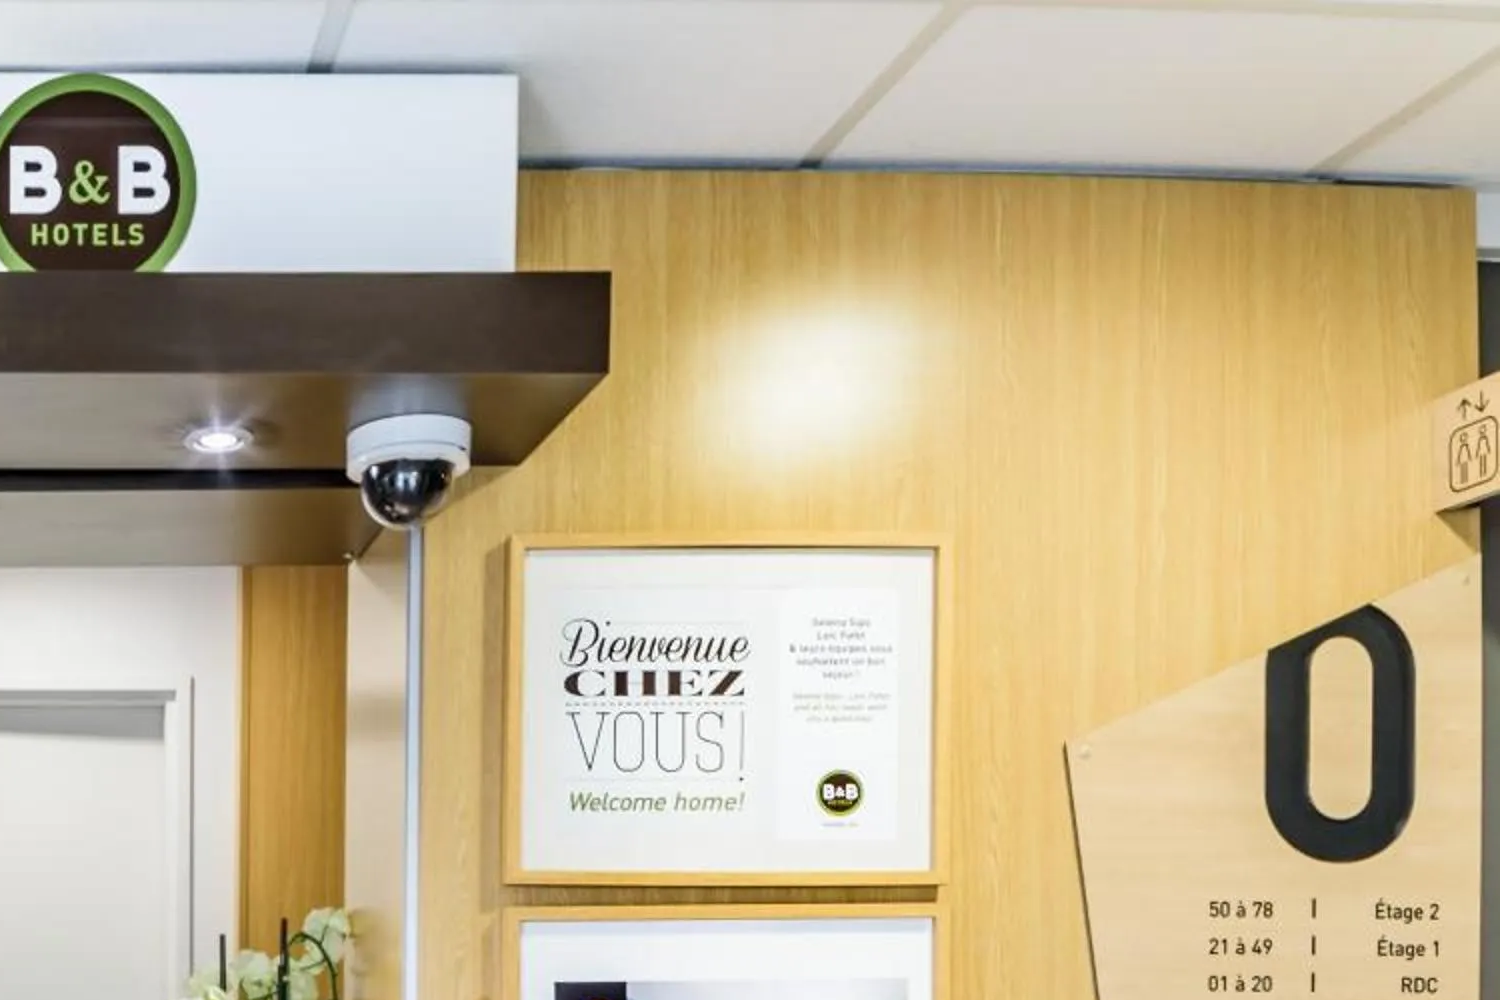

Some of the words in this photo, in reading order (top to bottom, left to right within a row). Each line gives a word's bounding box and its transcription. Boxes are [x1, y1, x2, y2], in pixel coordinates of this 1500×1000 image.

[9, 144, 171, 215] B&B
[30, 223, 145, 246] HOTELS
[560, 617, 751, 668] Bienvenue
[564, 670, 746, 697] CHEZ
[569, 791, 667, 812] Welcome
[674, 791, 745, 812] home!
[823, 783, 859, 800] B&B
[1209, 901, 1230, 918] 50
[1236, 899, 1247, 918] à
[1253, 901, 1274, 918] 78
[1375, 898, 1424, 922] Étage
[1429, 904, 1440, 921] 2
[1208, 938, 1229, 955] 21
[1235, 936, 1246, 955] à
[1251, 938, 1273, 955] 49
[1377, 935, 1426, 959] Étage
[1432, 940, 1440, 957] 1
[1208, 975, 1228, 992] 01
[1235, 974, 1245, 992] à
[1251, 975, 1273, 992] 20
[1400, 977, 1438, 993] RDC
